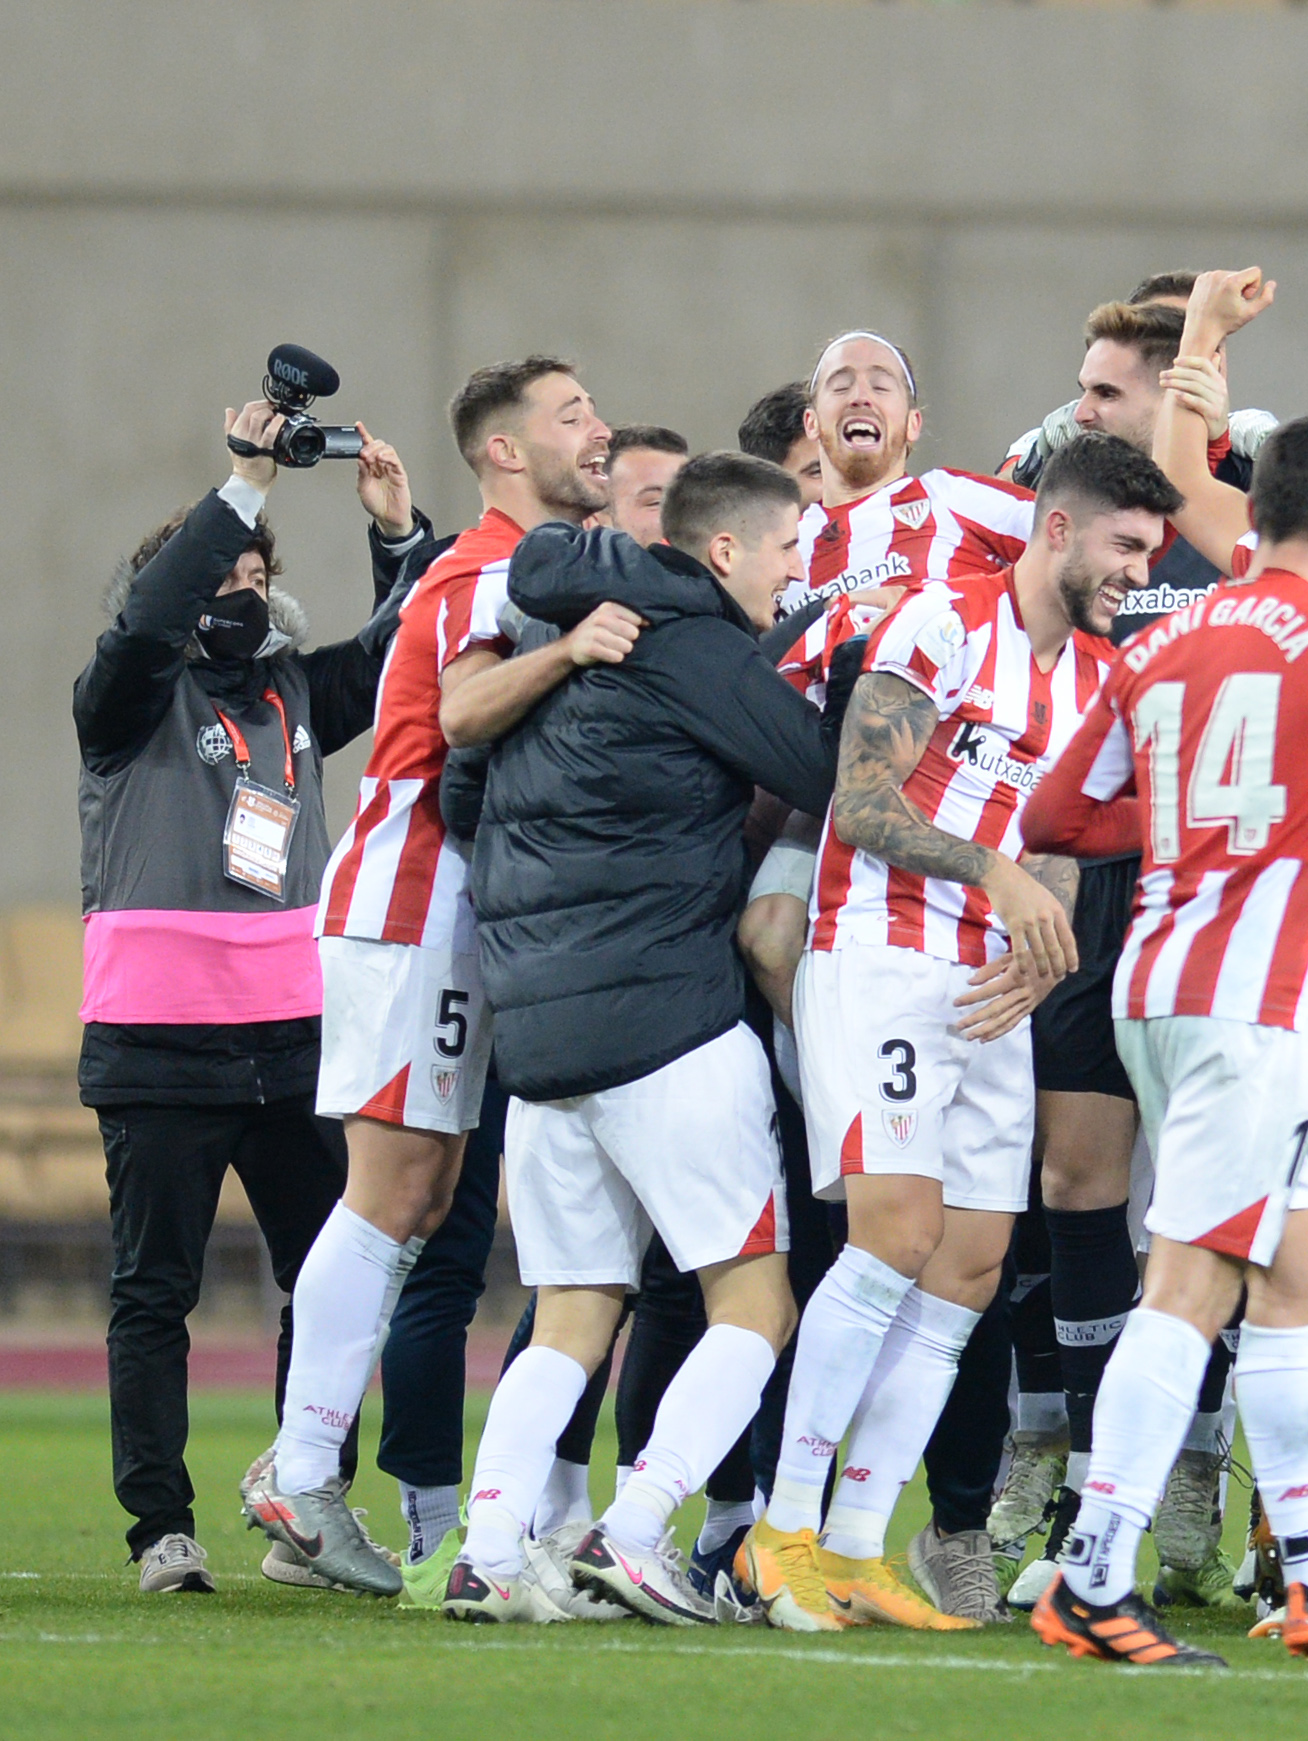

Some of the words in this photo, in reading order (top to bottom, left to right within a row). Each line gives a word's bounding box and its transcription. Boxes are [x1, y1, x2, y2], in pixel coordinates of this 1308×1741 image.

[273, 358, 309, 389] RØDE
[1123, 603, 1207, 674] DANI
[1131, 672, 1288, 865] 14
[433, 988, 470, 1060] 5
[877, 1038, 918, 1104] 3
